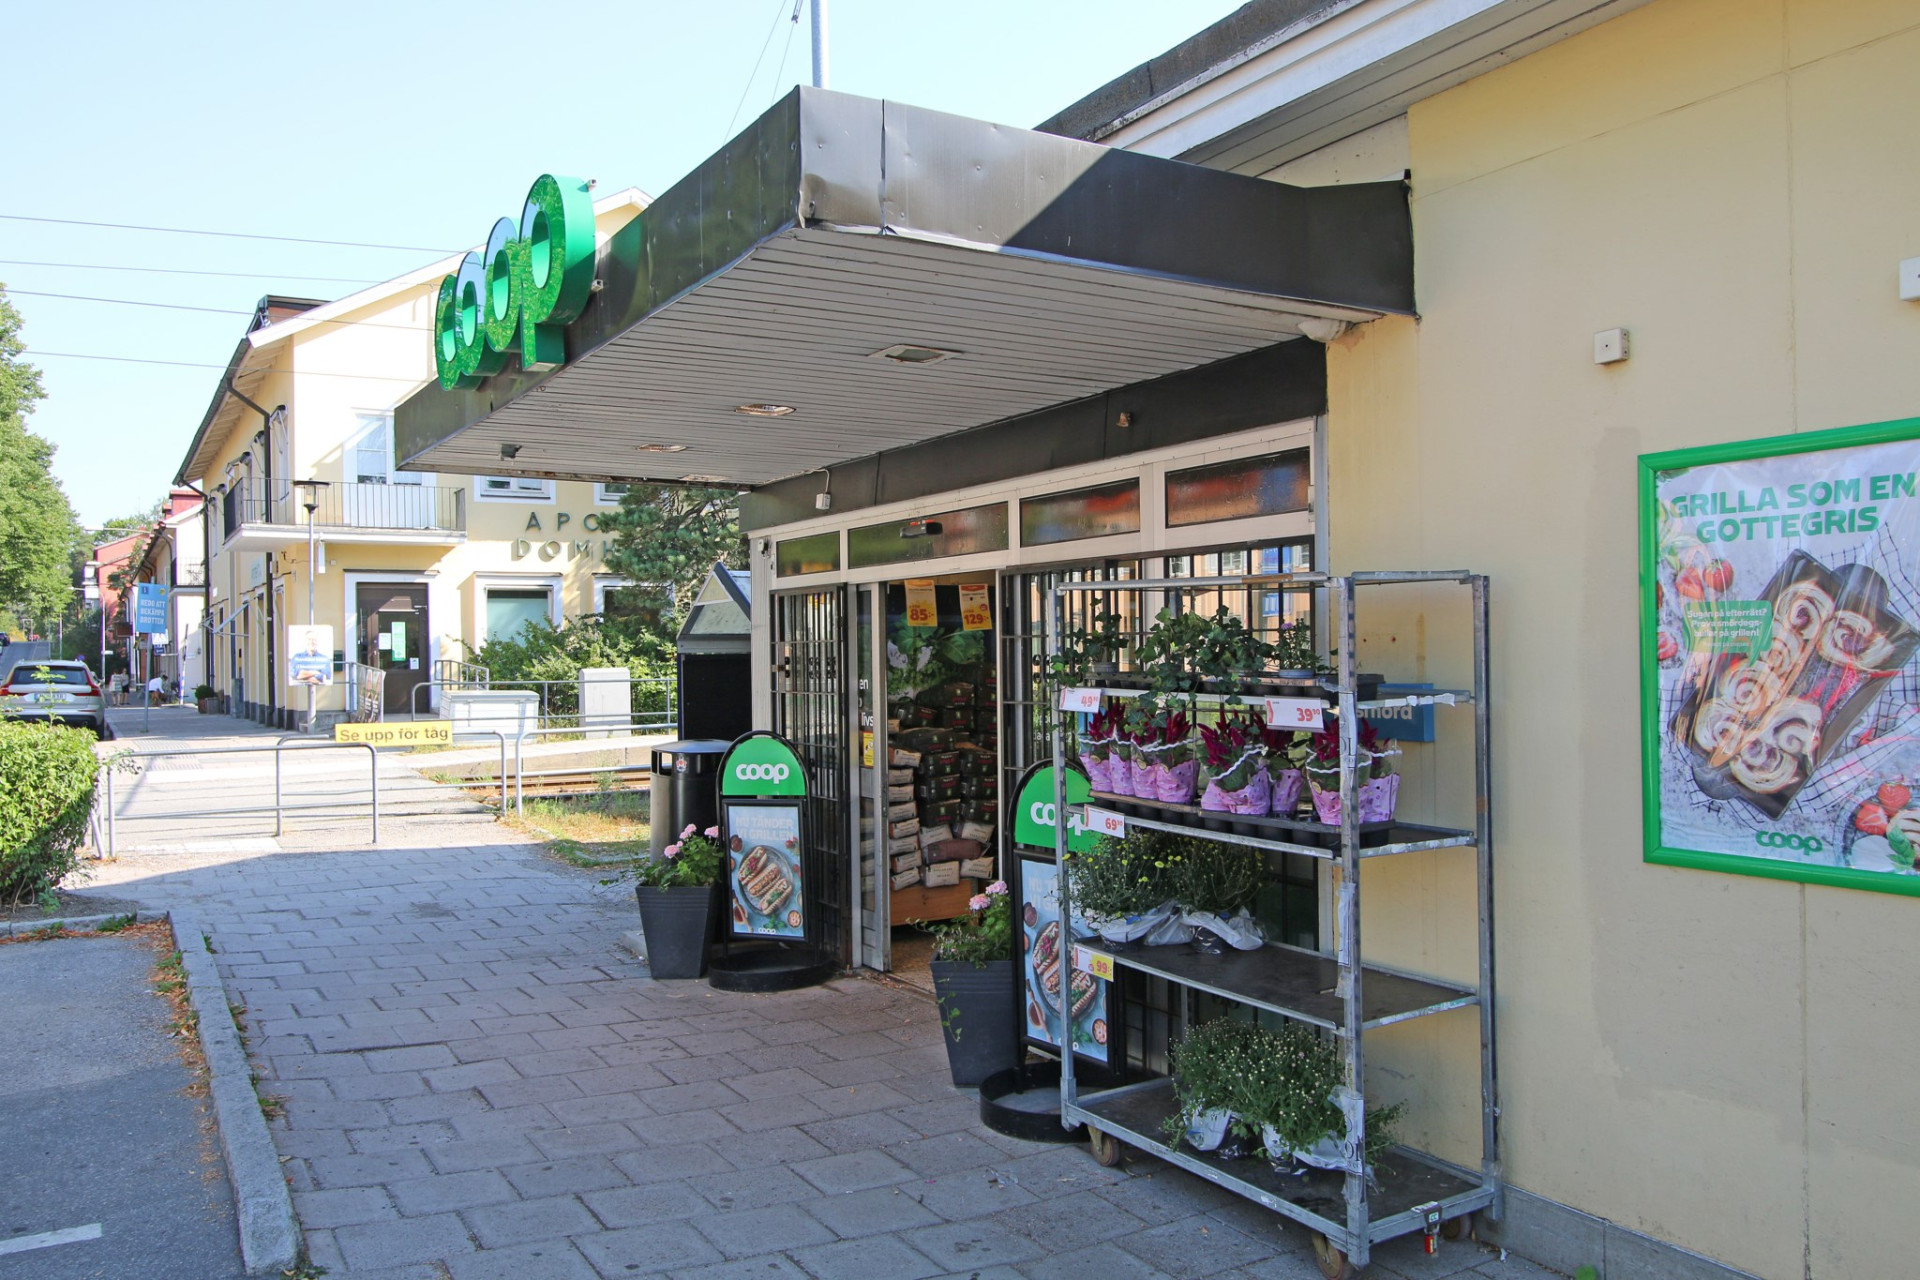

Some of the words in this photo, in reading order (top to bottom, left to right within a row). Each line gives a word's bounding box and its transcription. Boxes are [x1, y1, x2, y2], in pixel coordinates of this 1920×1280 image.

[435, 173, 578, 391] coop
[1669, 486, 1779, 518] GRILLA
[1786, 478, 1861, 508] SOM
[1868, 472, 1916, 501] EN
[1695, 505, 1880, 544] GOTTEGRIS
[1725, 608, 1767, 617] efterrätt?
[340, 730, 359, 741] Se
[365, 730, 394, 743] upp
[398, 728, 419, 740] för
[425, 727, 449, 740] tåg
[736, 763, 789, 784] coop
[749, 829, 794, 841] GRILLEN
[1755, 830, 1823, 856] coop
